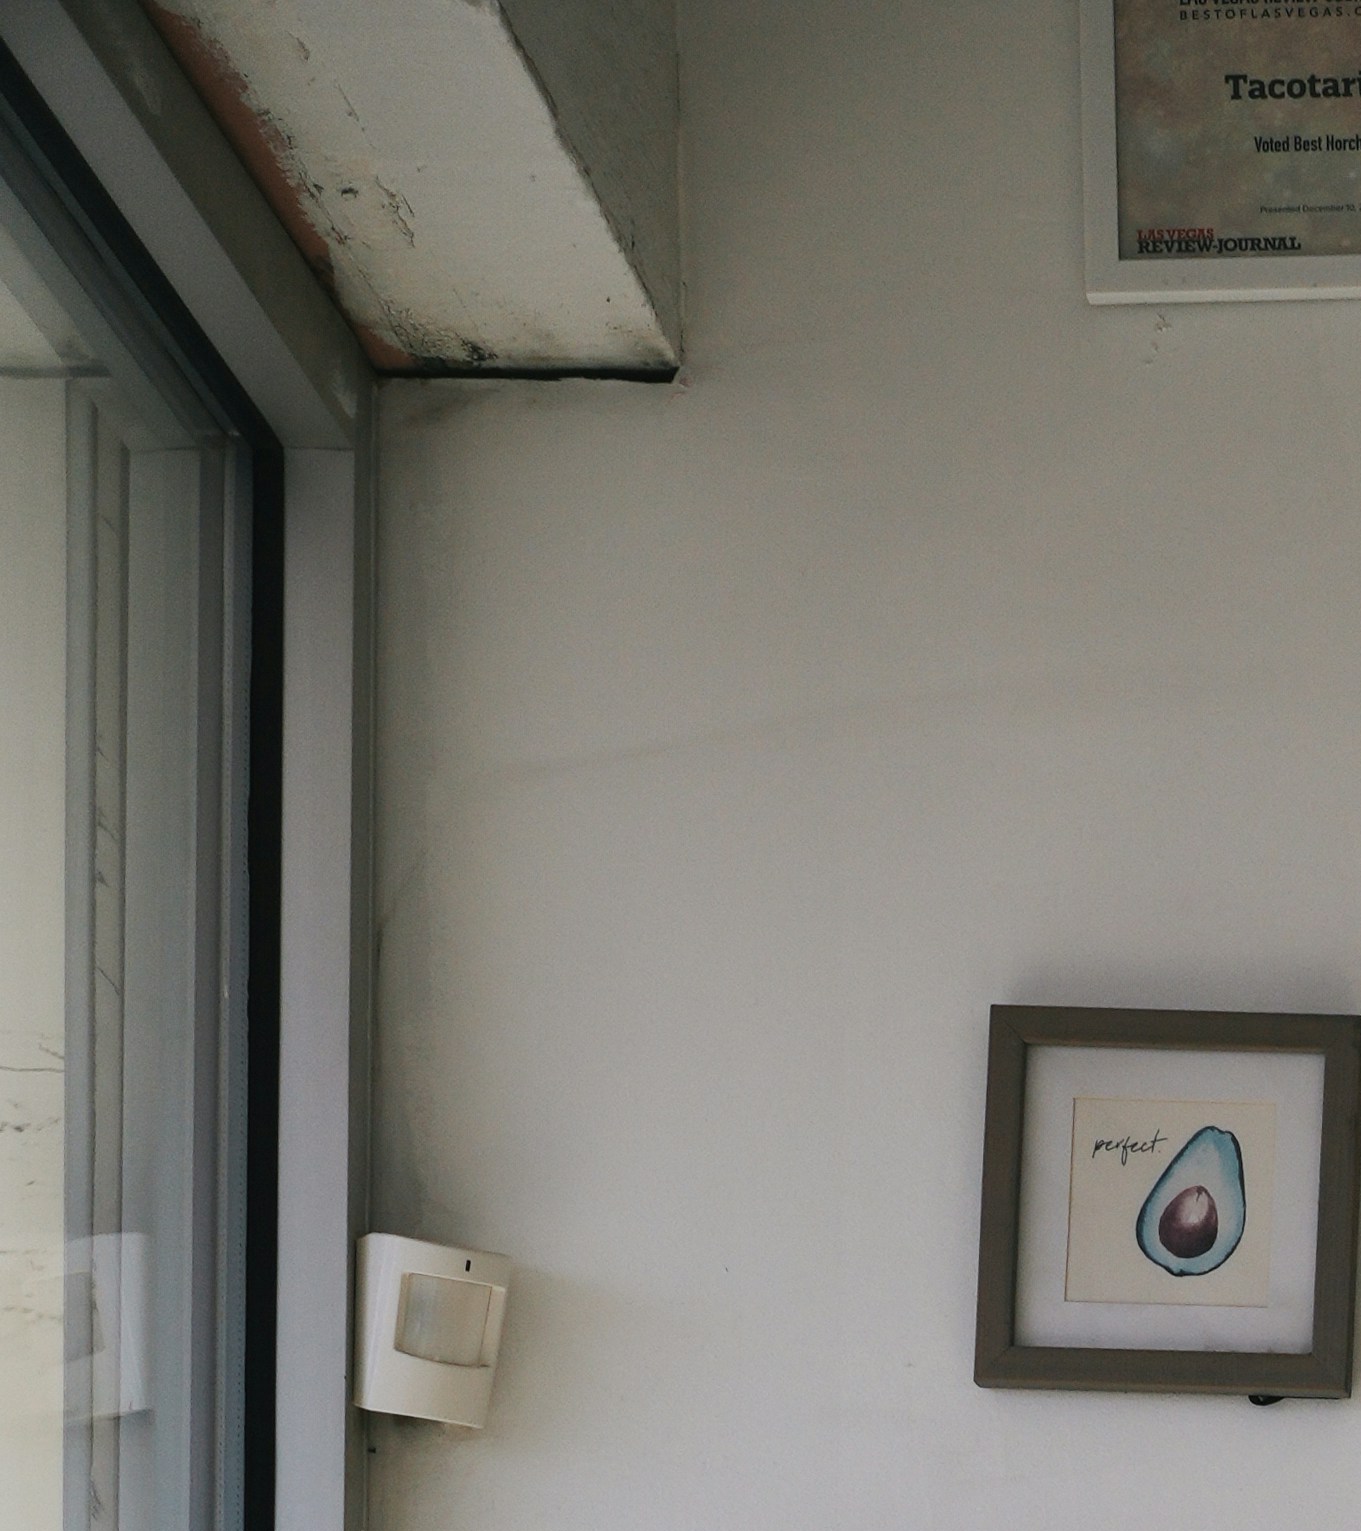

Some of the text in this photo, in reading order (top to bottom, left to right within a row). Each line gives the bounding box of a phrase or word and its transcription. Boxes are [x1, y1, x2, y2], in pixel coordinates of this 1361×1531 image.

[1254, 136, 1289, 152] Voted
[1294, 136, 1322, 152] Best
[1137, 229, 1214, 242] LAS VEGAS
[1137, 236, 1301, 254] REVIEW-JOURNAL
[1092, 1129, 1168, 1166] perfect.
